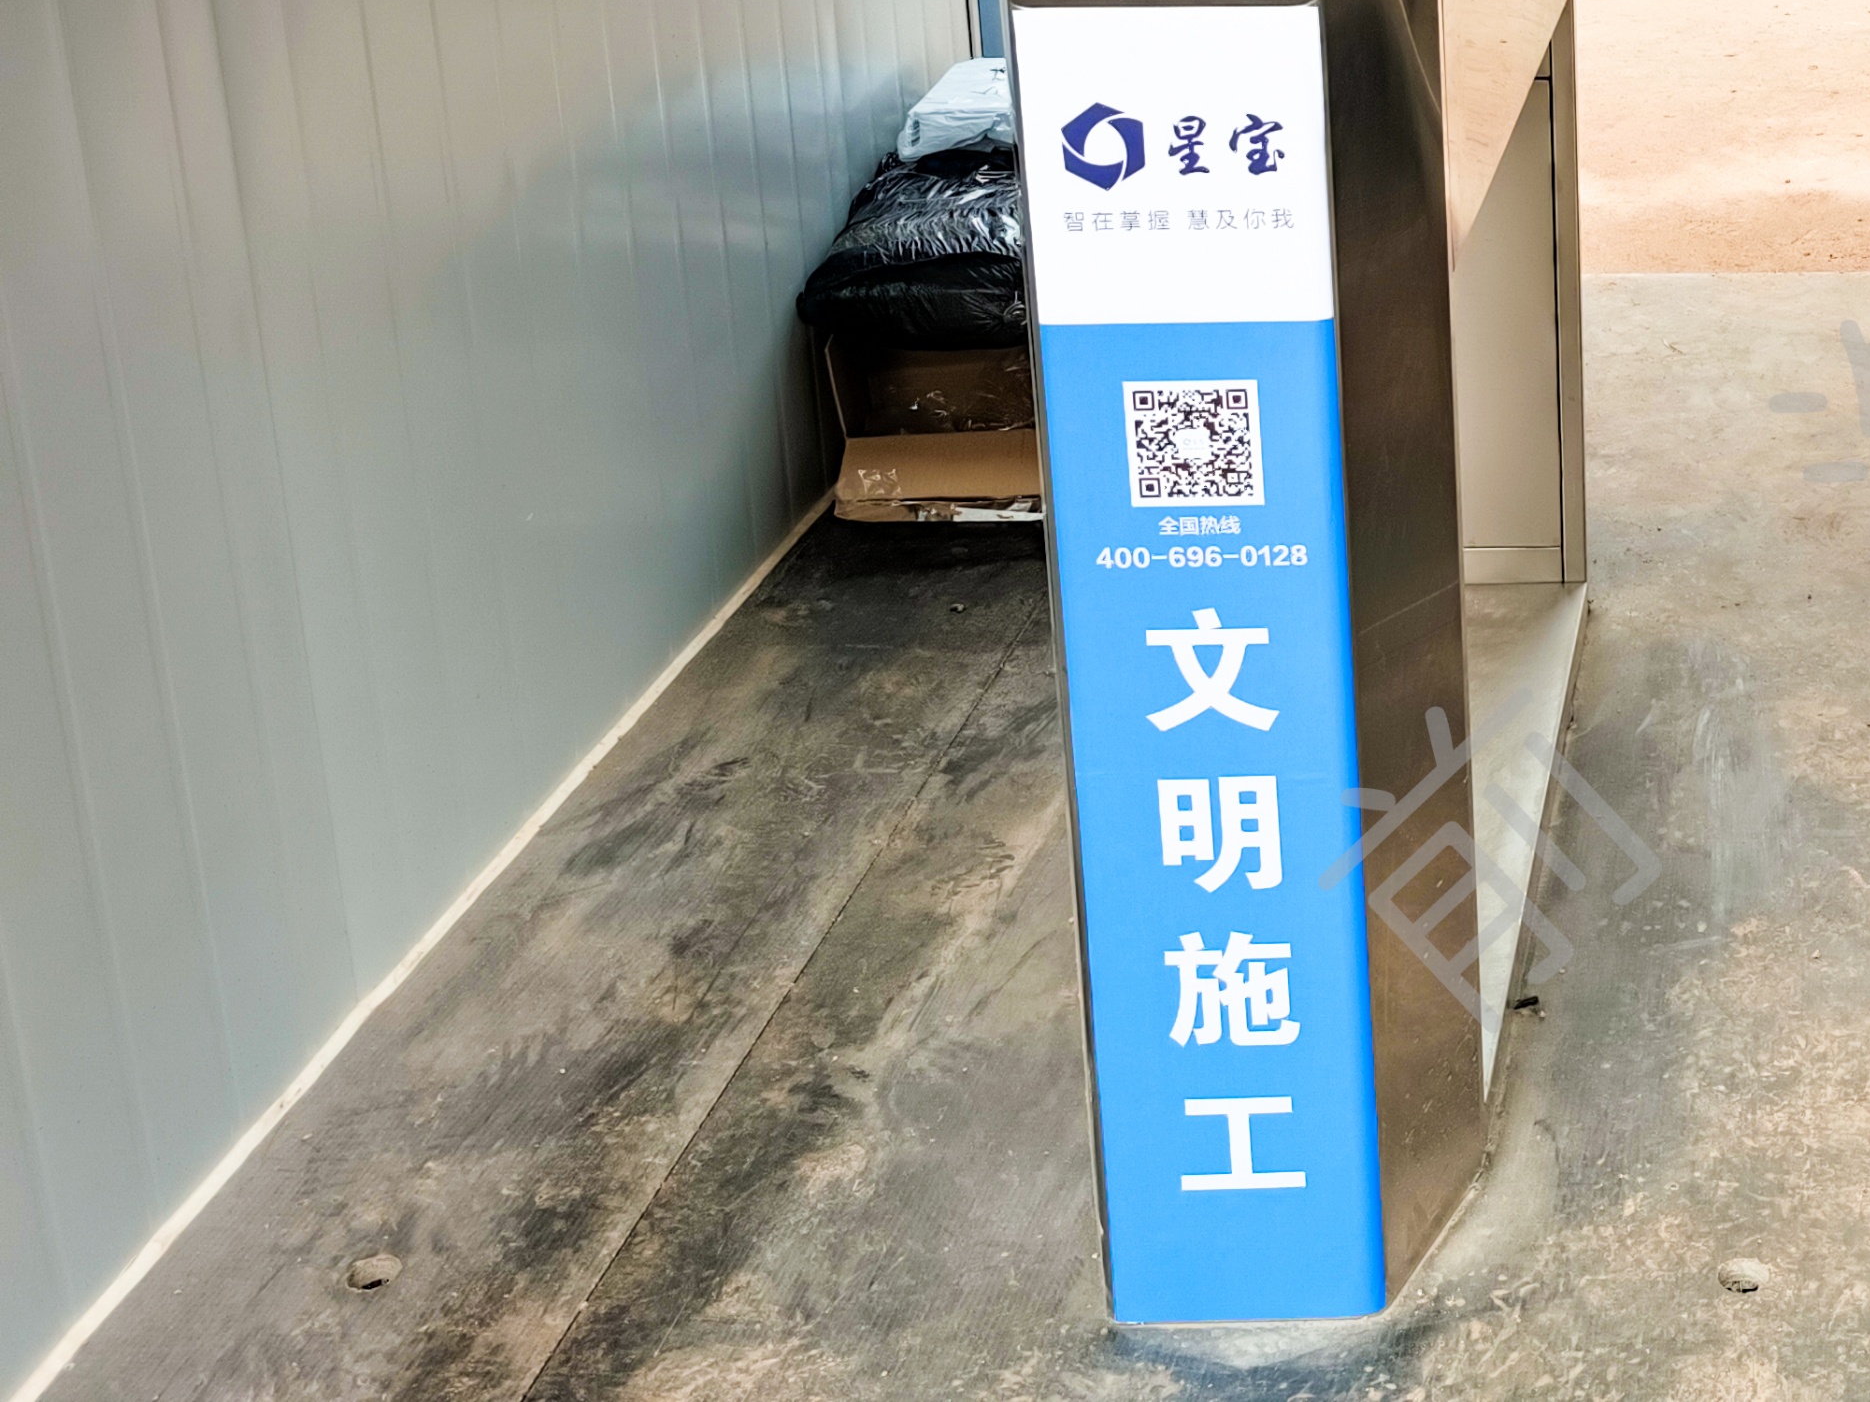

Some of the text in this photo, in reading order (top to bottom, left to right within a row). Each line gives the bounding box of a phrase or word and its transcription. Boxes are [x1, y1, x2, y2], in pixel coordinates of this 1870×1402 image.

[1167, 113, 1285, 176] 星宝
[1063, 208, 1295, 232] 智在掌握 慧及你我
[1158, 515, 1242, 536] 全国热线
[1096, 544, 1309, 569] 400-696-0128
[1145, 607, 1307, 1192] 文明施工
